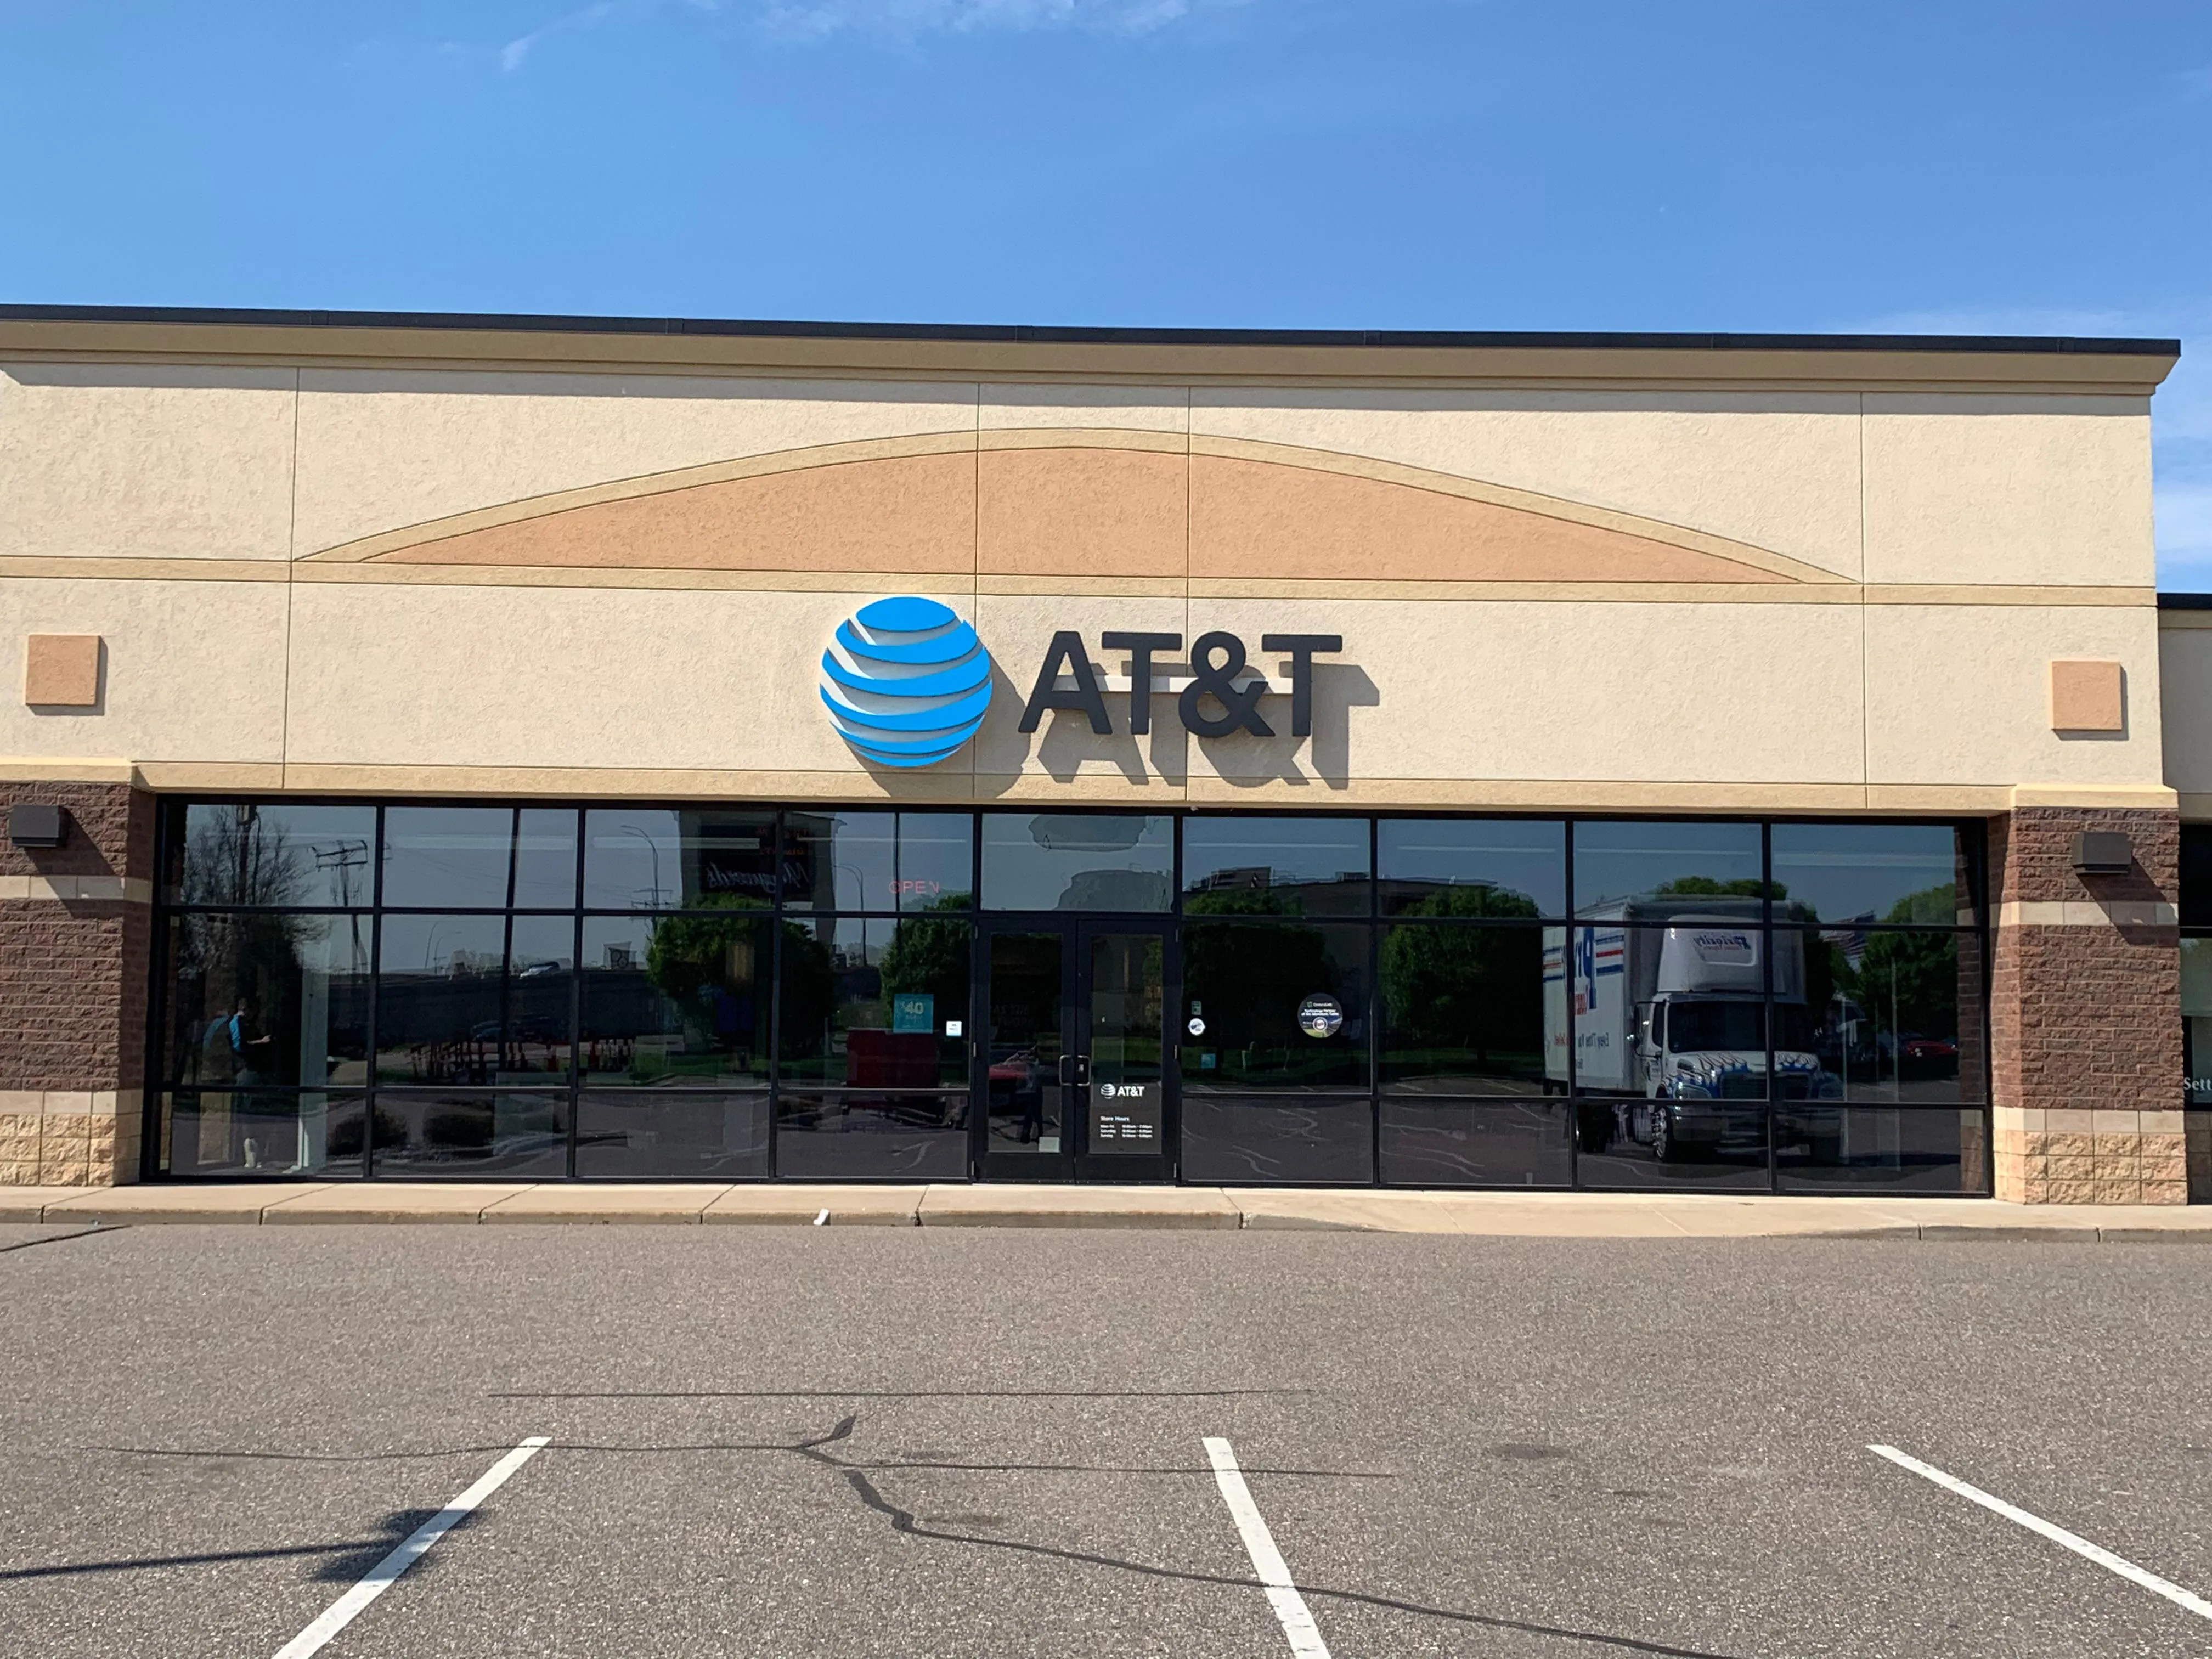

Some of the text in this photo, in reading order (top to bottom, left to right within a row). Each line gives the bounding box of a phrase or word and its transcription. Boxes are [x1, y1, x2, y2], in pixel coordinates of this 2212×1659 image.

[1018, 630, 1342, 737] AT&T
[888, 880, 939, 894] OPEN
[1117, 1086, 1145, 1097] AT&T
